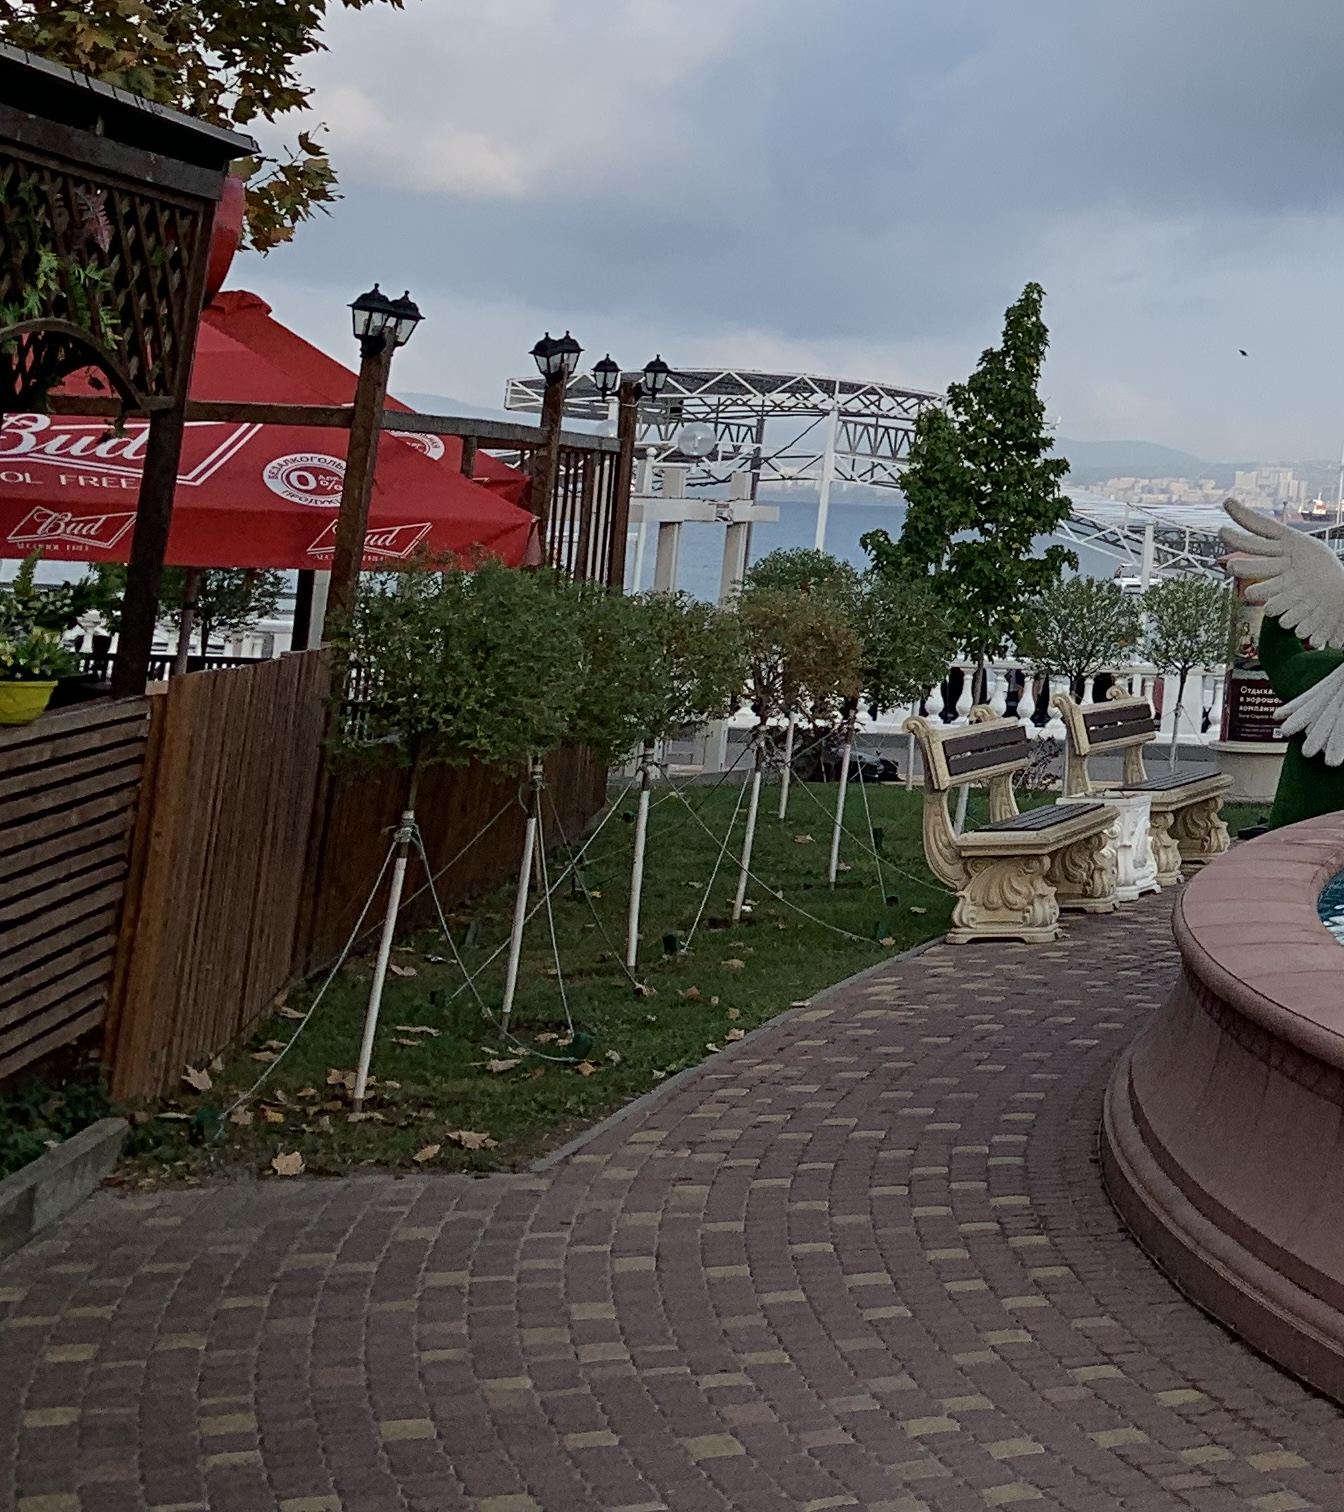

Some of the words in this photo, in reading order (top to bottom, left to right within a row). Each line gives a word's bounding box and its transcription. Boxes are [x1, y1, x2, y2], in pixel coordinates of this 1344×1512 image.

[0, 413, 149, 460] Bud
[268, 455, 346, 479] БЕЗАЛКОГОЛЬ
[59, 474, 140, 489] FREE
[33, 511, 106, 536] Bud
[1240, 686, 1275, 694] Отдыха
